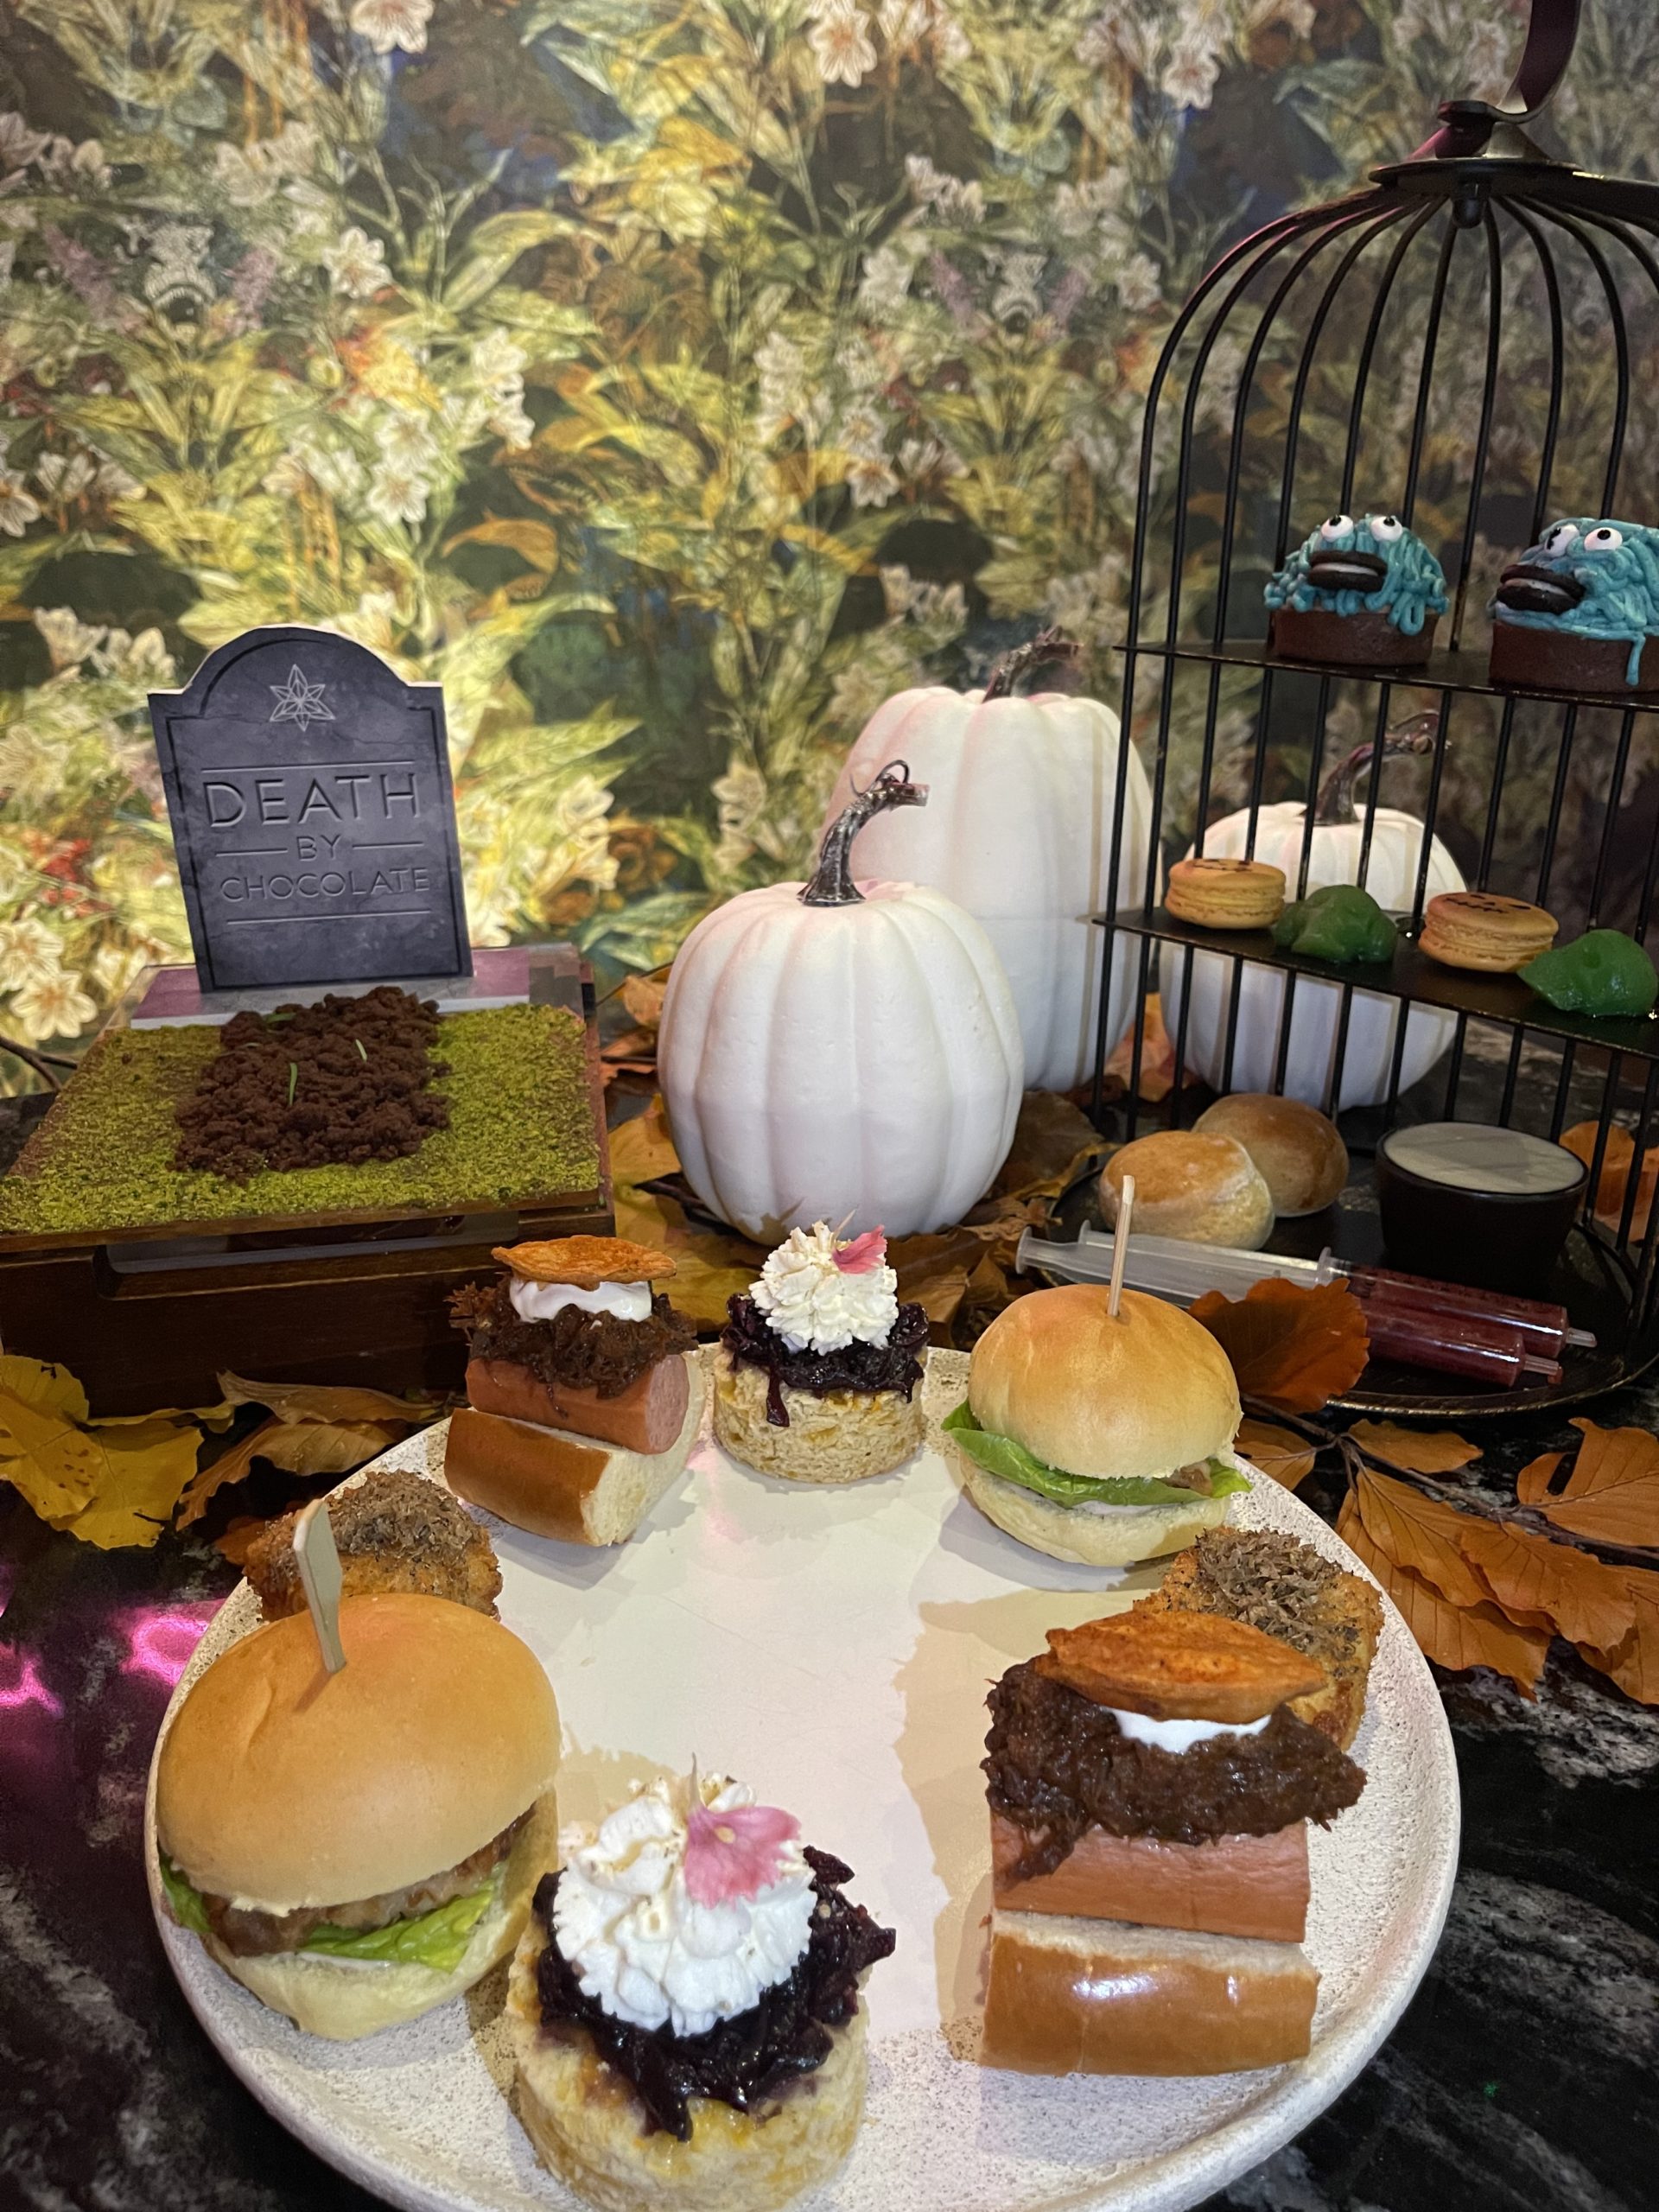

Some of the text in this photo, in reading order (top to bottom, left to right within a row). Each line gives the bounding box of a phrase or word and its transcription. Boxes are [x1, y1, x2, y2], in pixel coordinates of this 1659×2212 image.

[203, 773, 420, 828] DEATH
[296, 834, 341, 861] BY
[219, 868, 430, 902] CHOCOLATE
